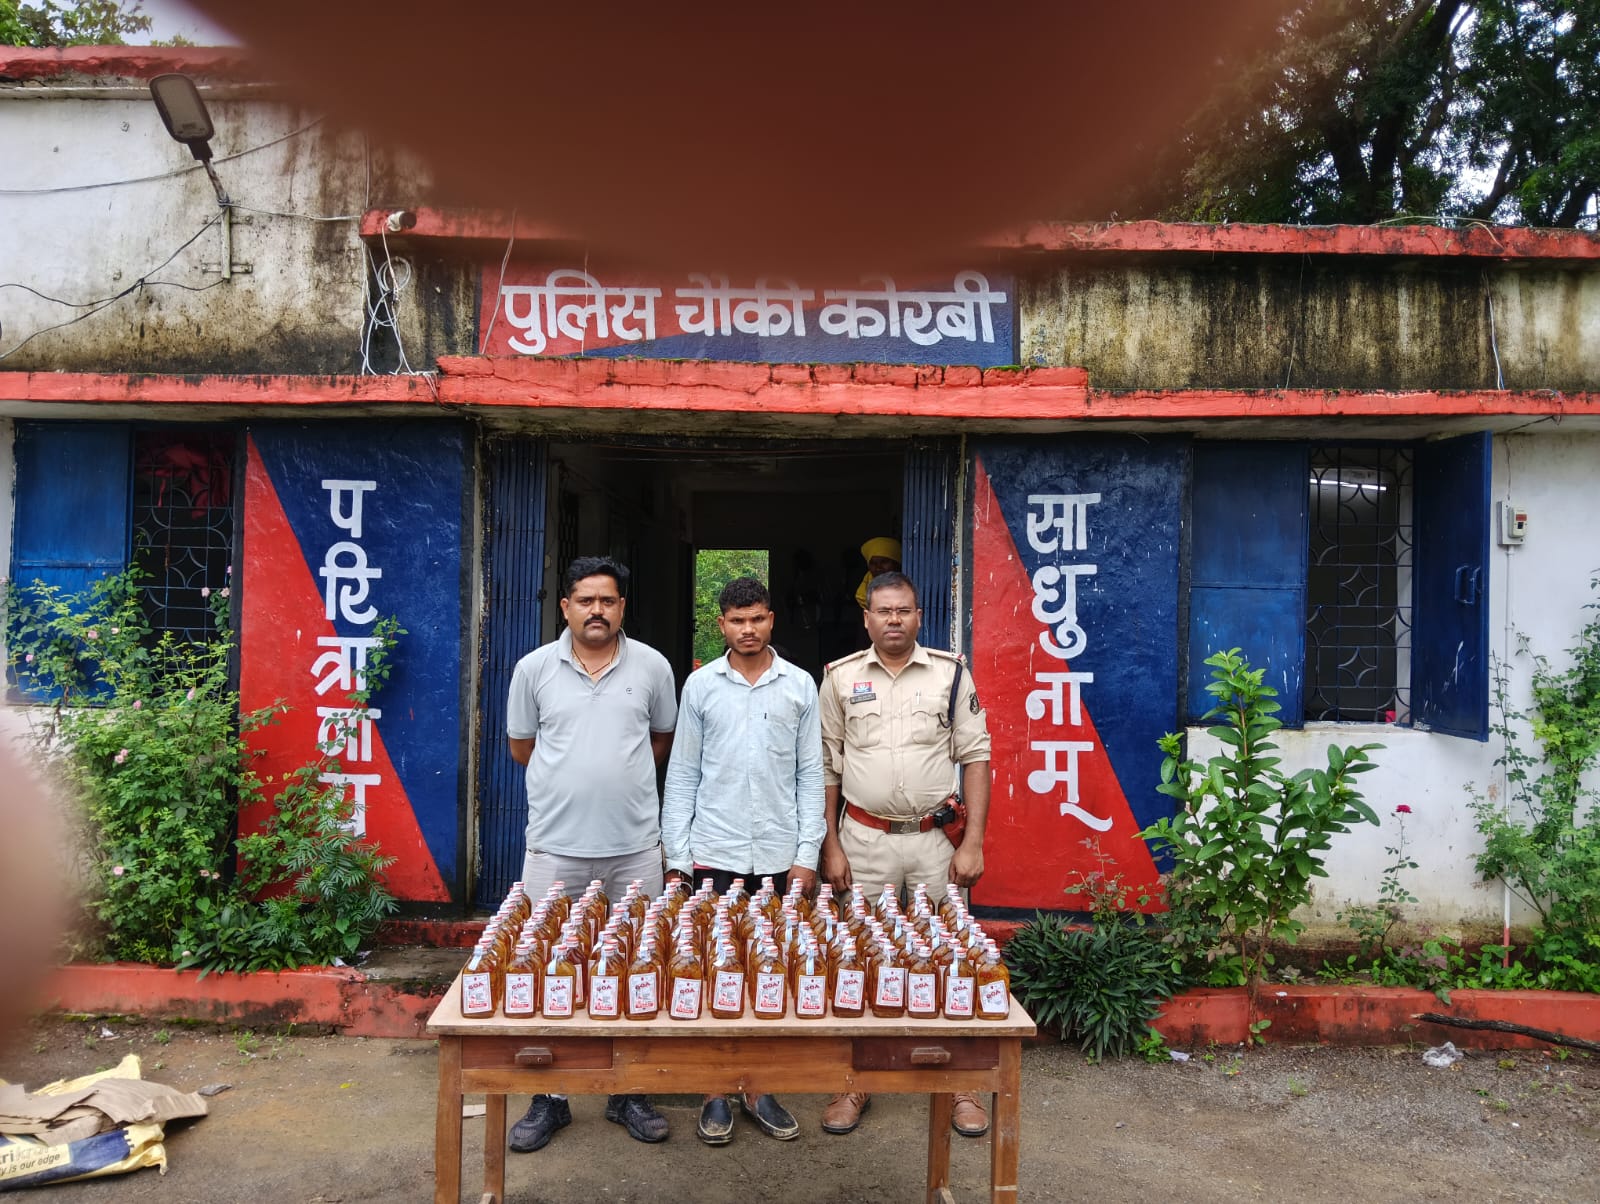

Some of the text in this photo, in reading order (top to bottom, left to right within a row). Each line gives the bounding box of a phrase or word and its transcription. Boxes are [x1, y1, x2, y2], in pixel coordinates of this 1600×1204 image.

[501, 269, 662, 355] पुलिस
[818, 271, 1007, 346] कोरबी
[596, 984, 612, 993] GOA
[635, 982, 650, 990] GOA
[986, 990, 1001, 999] GOA
[0, 1150, 14, 1164] ri
[9, 1165, 17, 1174] is
[20, 1160, 36, 1170] our
[37, 1153, 61, 1165] edge
